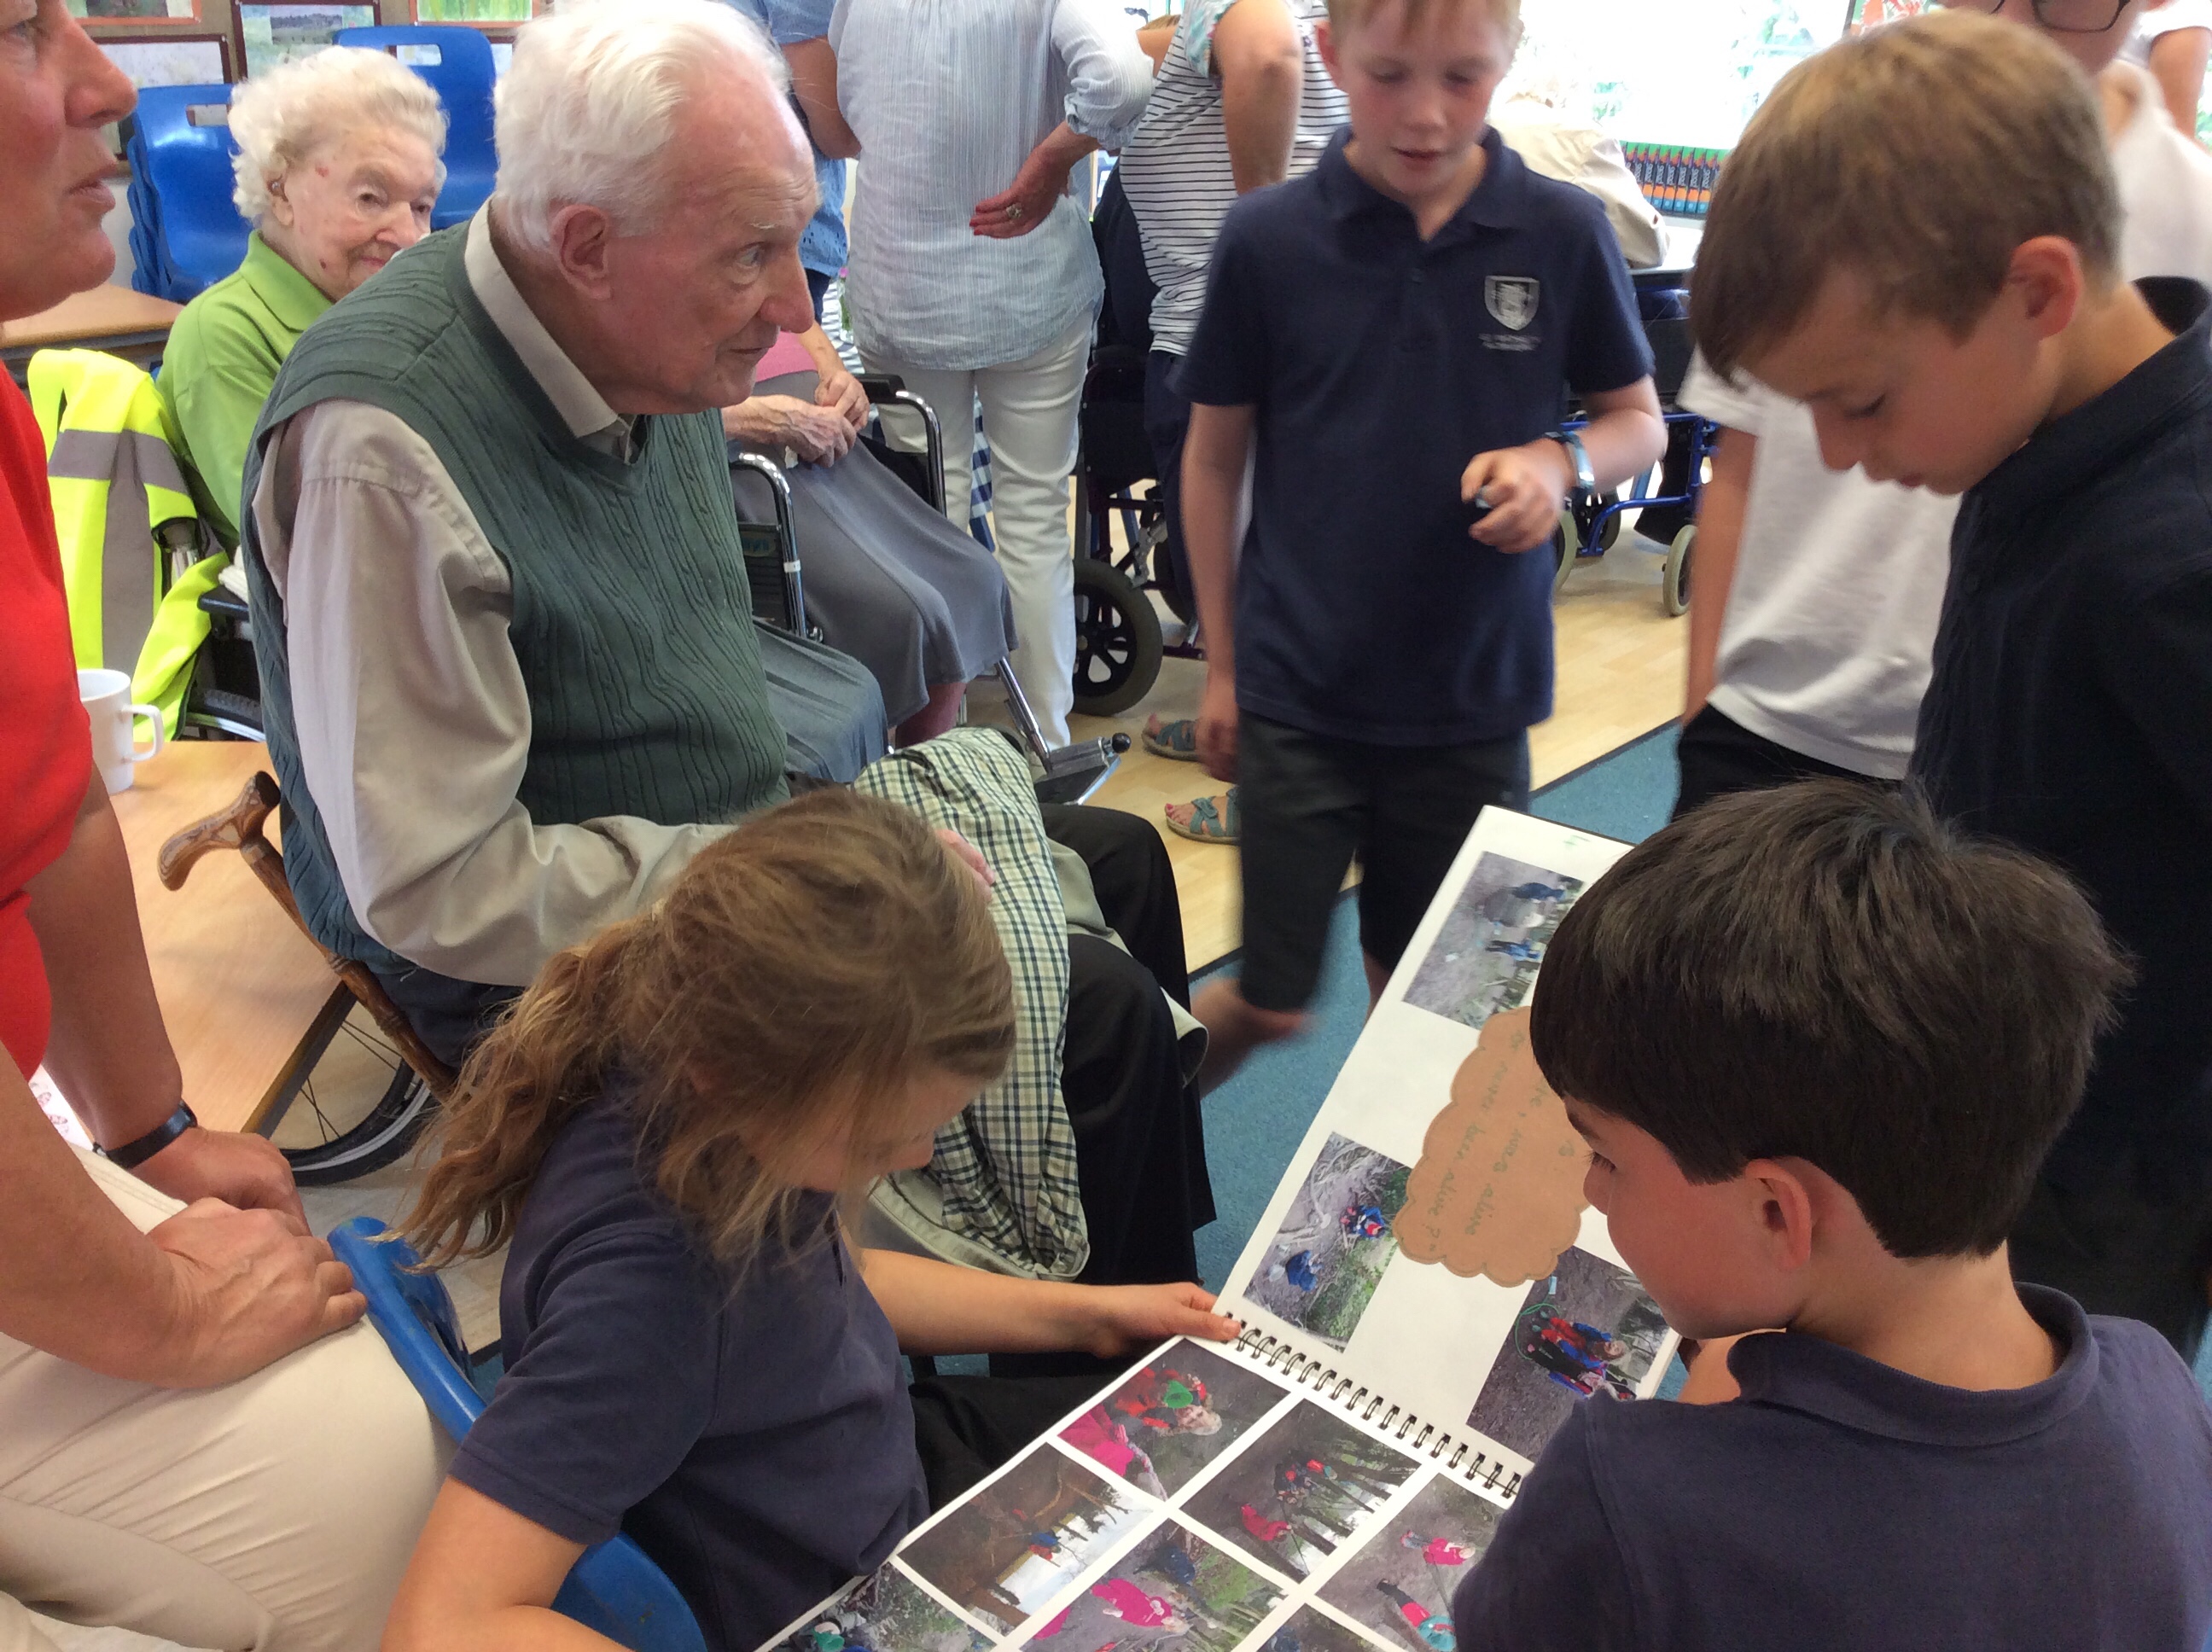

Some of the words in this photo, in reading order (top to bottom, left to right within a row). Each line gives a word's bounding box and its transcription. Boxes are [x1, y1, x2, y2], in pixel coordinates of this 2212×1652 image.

[1481, 1062, 1509, 1114] never
[1456, 1122, 1486, 1160] been
[1493, 1127, 1523, 1172] was
[1464, 1183, 1494, 1236] alive
